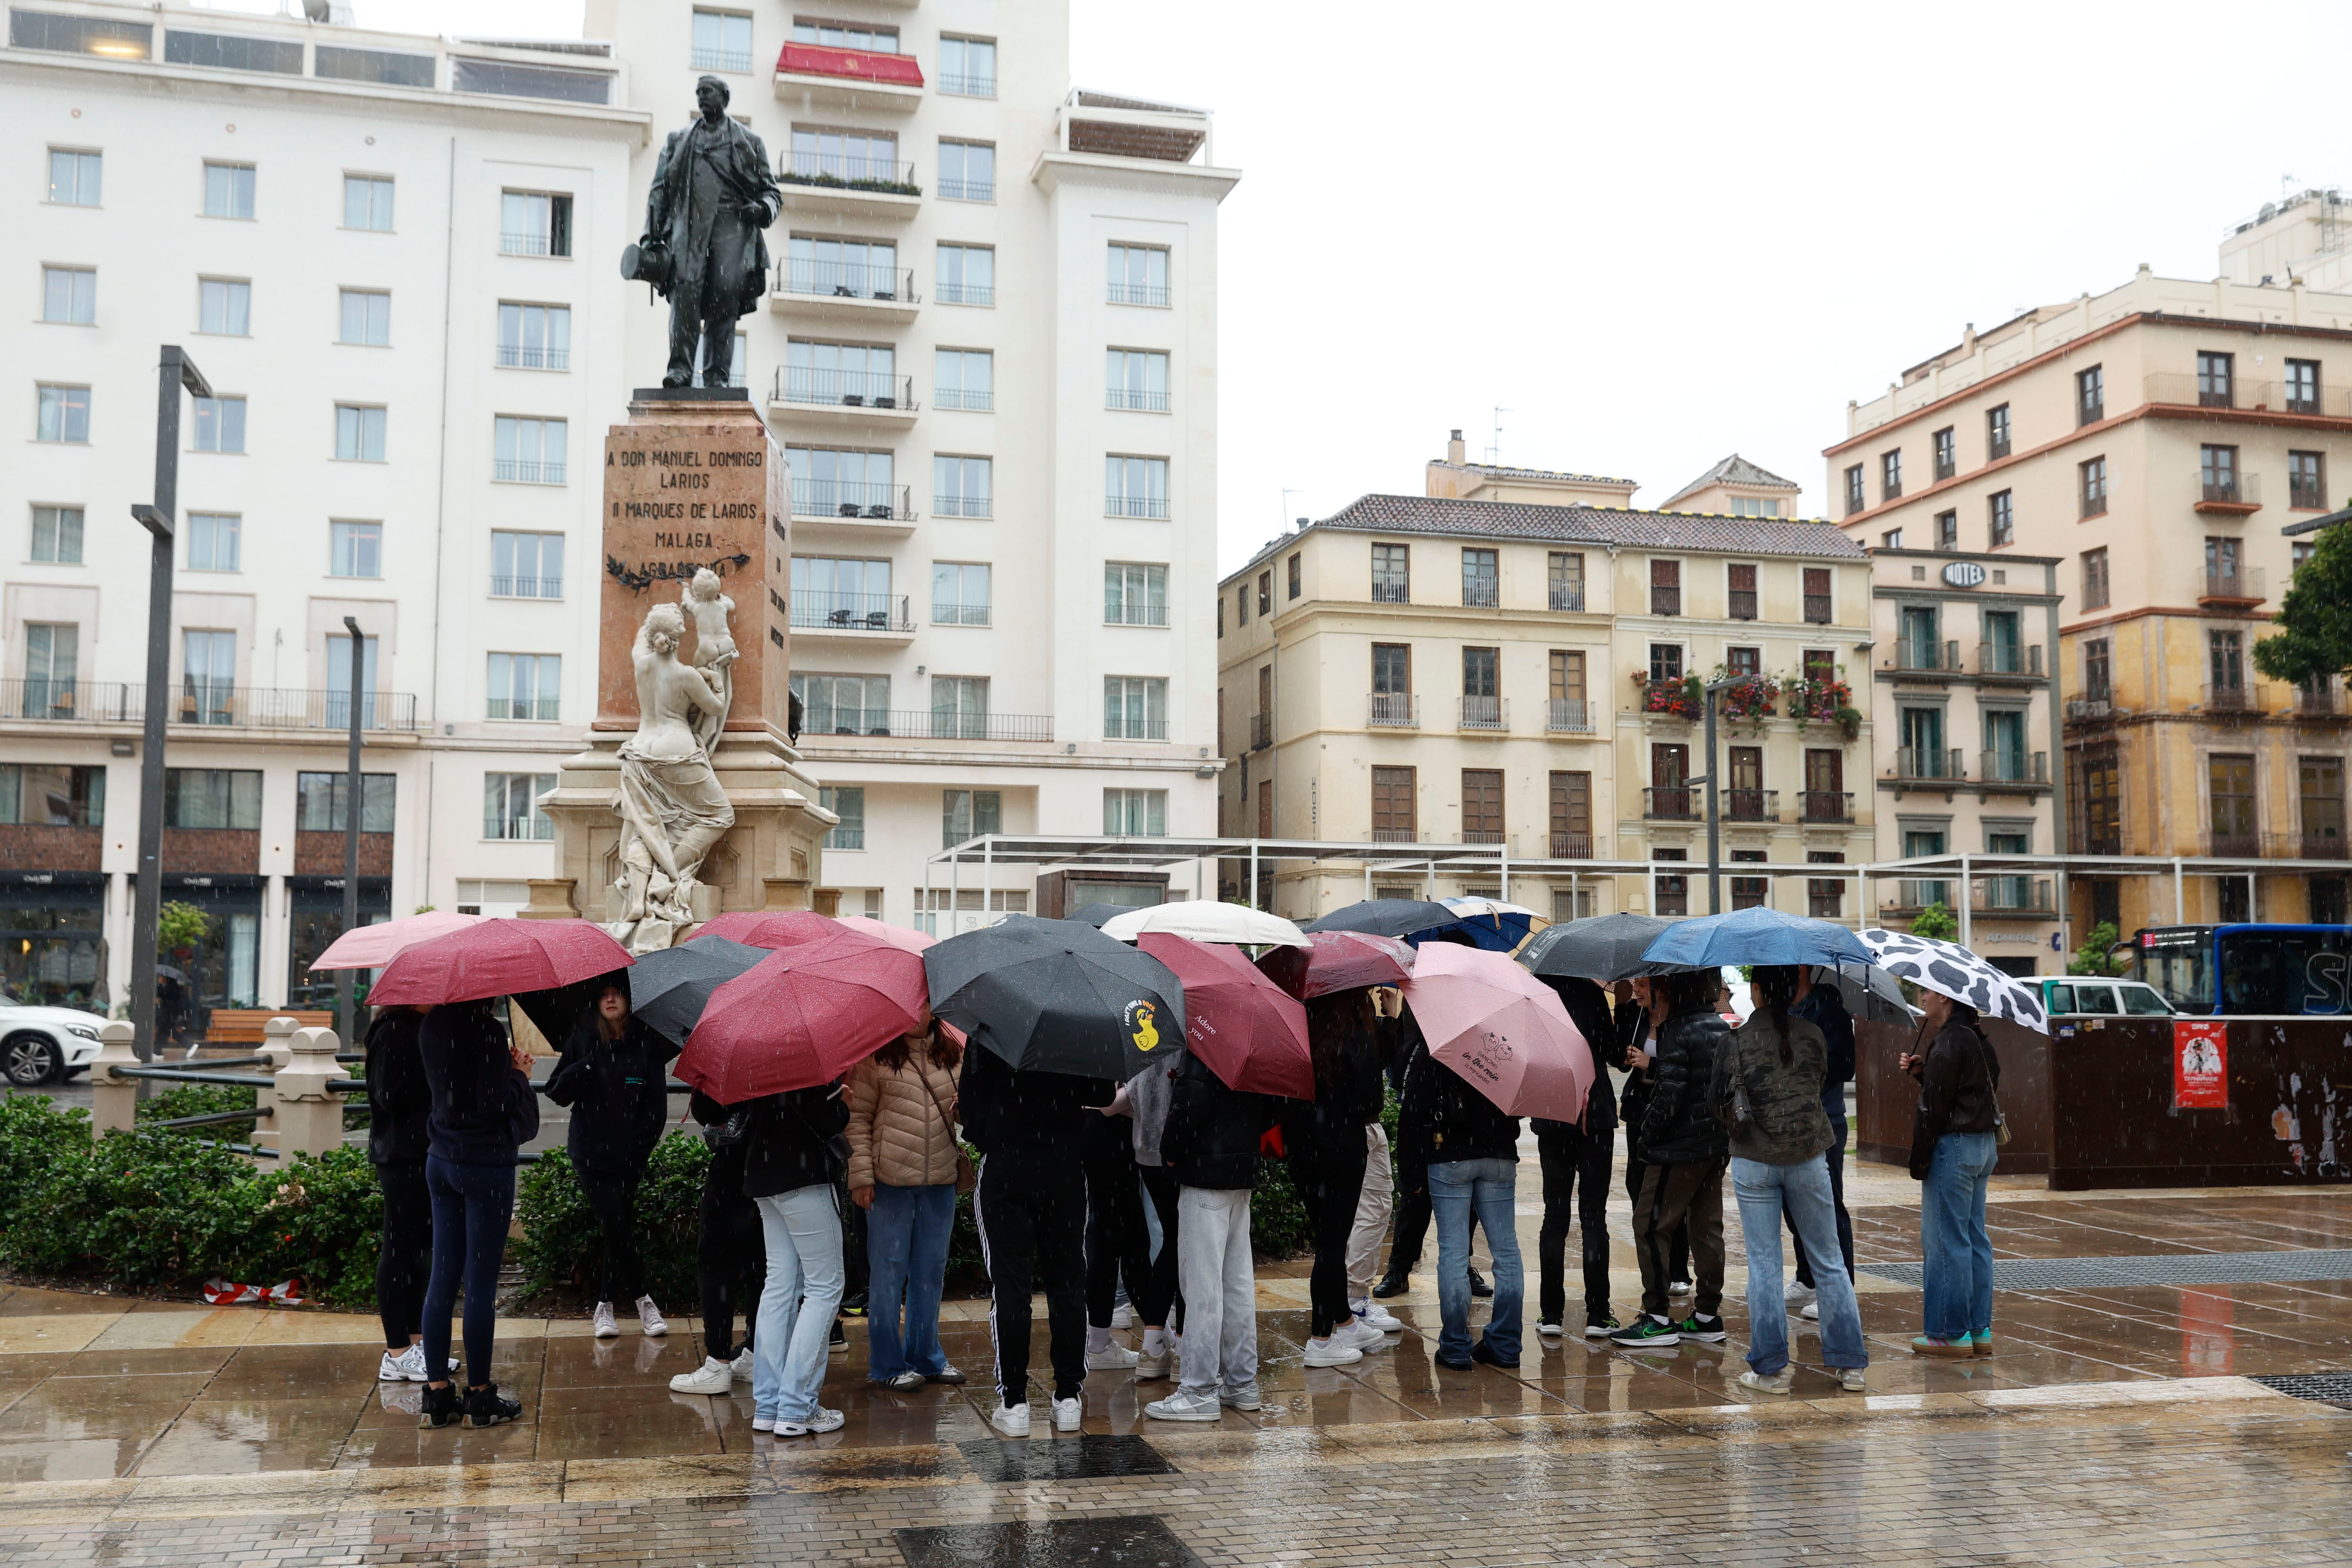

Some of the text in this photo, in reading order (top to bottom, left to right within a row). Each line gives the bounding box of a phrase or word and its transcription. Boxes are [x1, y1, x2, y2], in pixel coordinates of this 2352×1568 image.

[608, 451, 762, 467] A DON MANUEL DOMINGO
[661, 473, 710, 488] LARIOS
[613, 502, 756, 519] II MARQUES DE LARIOS
[655, 532, 713, 548] MALAGA
[1946, 563, 1984, 585] HOTEL
[1986, 933, 2039, 943] ADMIRAL
[1142, 1000, 1156, 1012] DUCK
[1195, 1015, 1216, 1035] Adore
[1188, 1027, 1204, 1041] you
[1411, 1041, 1421, 1056] adidas
[1477, 1051, 1498, 1069] DANCING
[1472, 1058, 1484, 1069] the
[1484, 1068, 1500, 1081] rain
[1476, 1073, 1490, 1084] cardio
